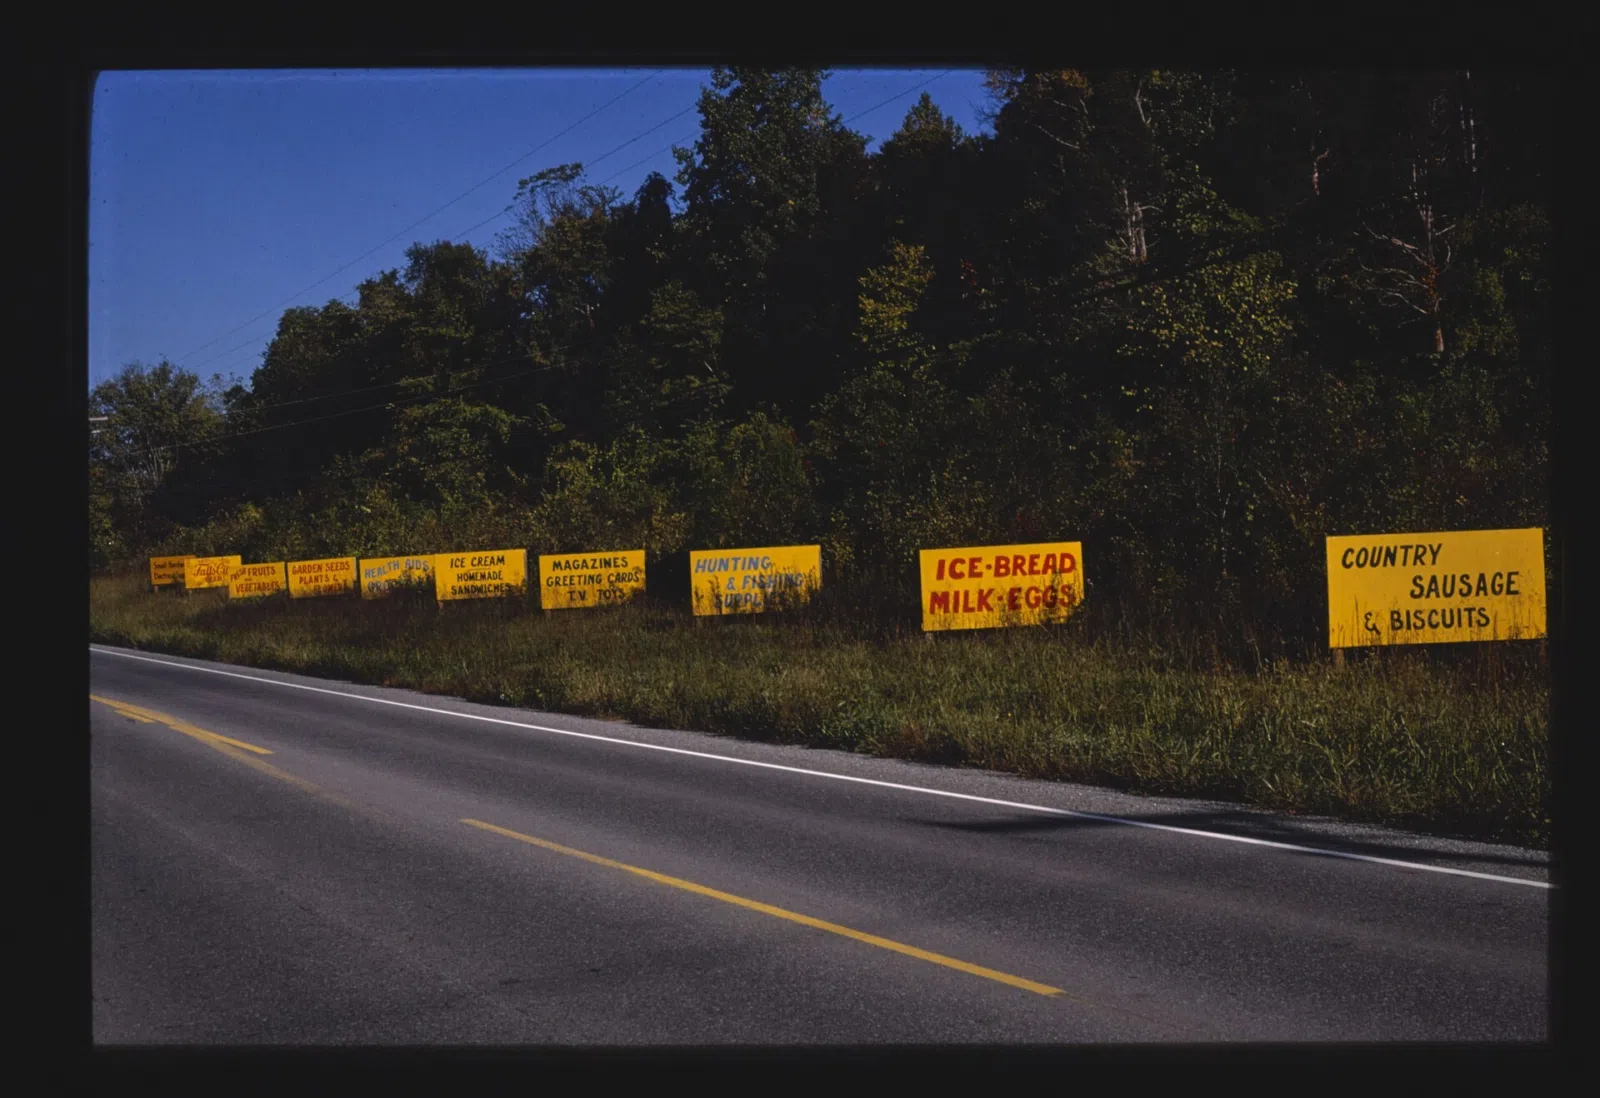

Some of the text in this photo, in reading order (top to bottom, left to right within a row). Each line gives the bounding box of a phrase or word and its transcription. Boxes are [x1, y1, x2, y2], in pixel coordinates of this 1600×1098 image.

[450, 555, 506, 569] ICE CREAM
[1341, 543, 1443, 569] COUNTRY
[247, 566, 276, 576] FRUITS
[292, 561, 350, 575] GARDEN SEEDS
[365, 560, 400, 579] HEALTH
[404, 558, 430, 571] AIDS
[552, 557, 629, 571] MAGAZINES
[695, 556, 772, 573] HUNTING
[299, 574, 330, 585] PLANTS
[457, 570, 504, 582] HOMEMADE
[546, 571, 640, 587] GREETING CARDS
[726, 572, 804, 590] & FISHING
[451, 582, 512, 595] SANDWICHES
[1409, 571, 1520, 599] SAUSAGE
[597, 588, 626, 600] TOYS
[1390, 607, 1490, 631] BISCUITS
